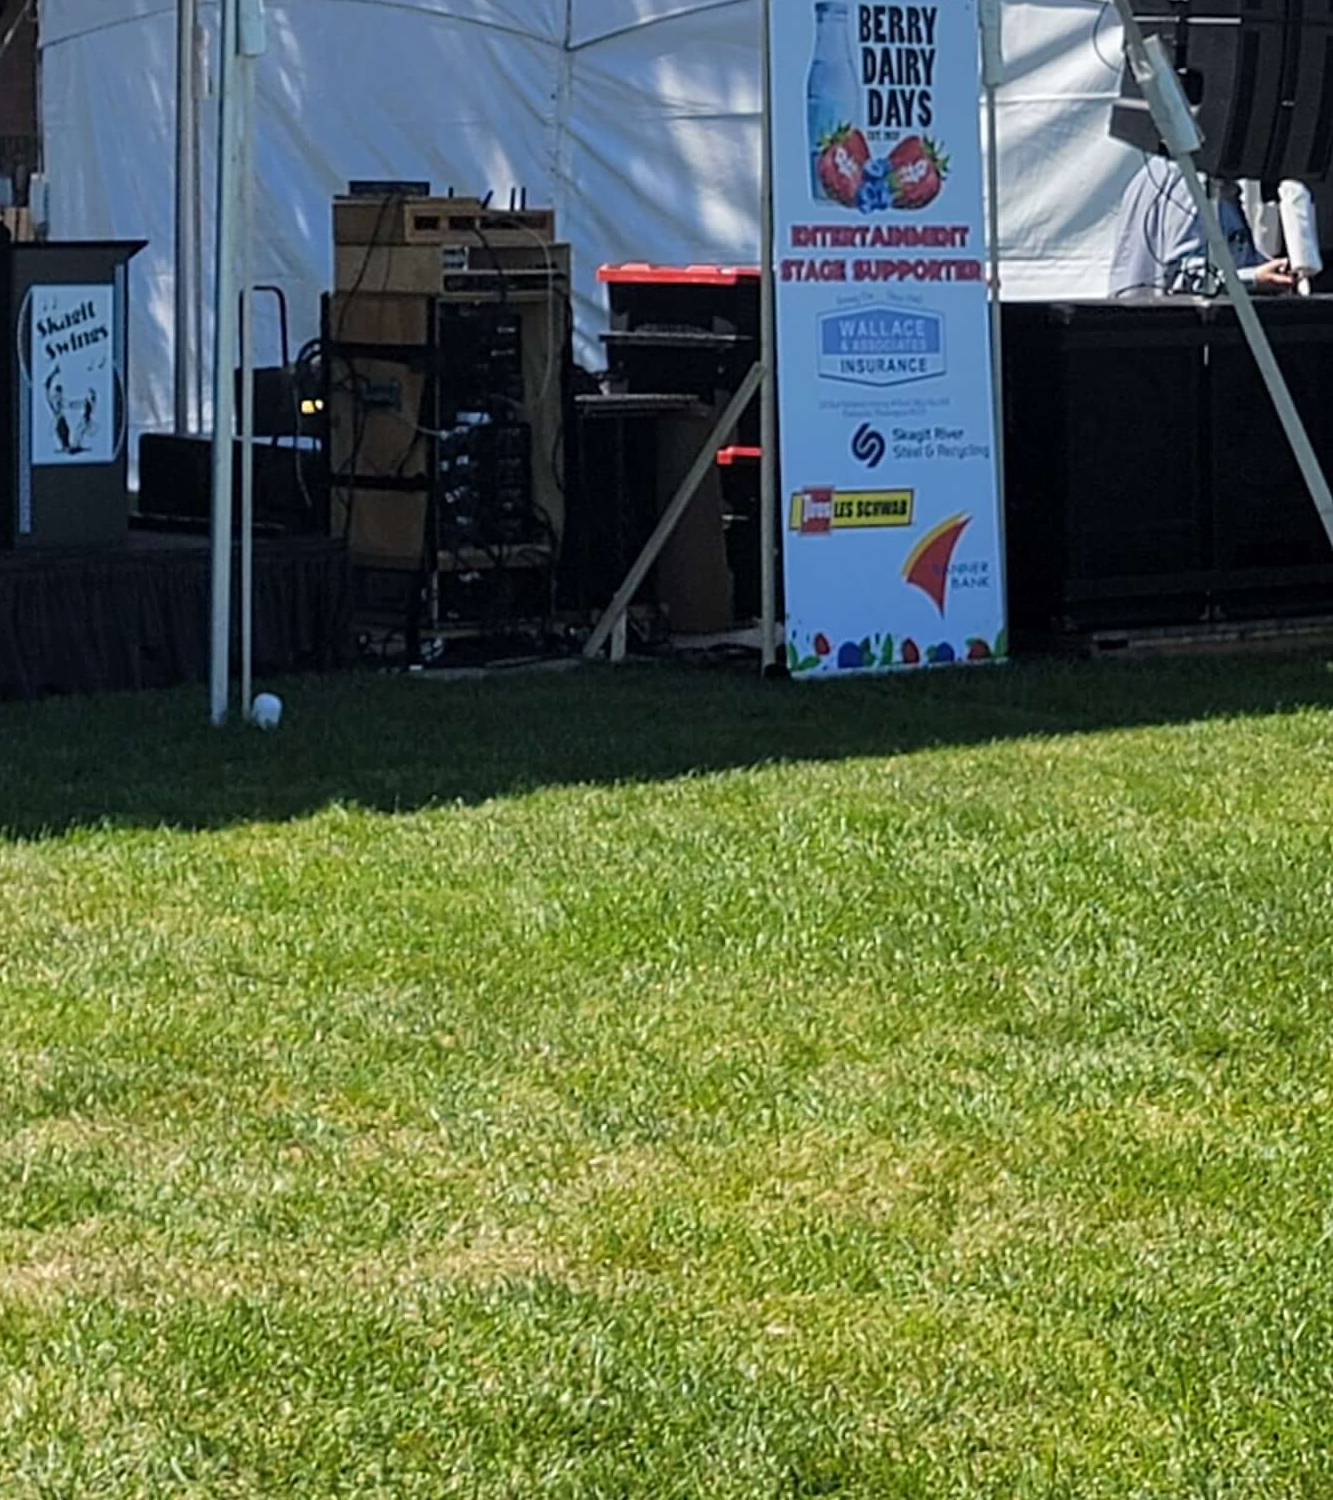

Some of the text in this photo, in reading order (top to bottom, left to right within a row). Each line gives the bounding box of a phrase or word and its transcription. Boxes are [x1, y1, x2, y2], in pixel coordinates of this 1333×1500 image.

[858, 4, 938, 46] BERRY
[861, 46, 936, 87] DAIRY
[868, 88, 933, 128] DAYS
[791, 224, 970, 249] ENTERTAINMENT
[781, 258, 982, 282] STAGE SUPPORTER
[36, 301, 97, 340] Skagit
[838, 318, 926, 338] WALLACE
[44, 325, 109, 360] Swings
[840, 357, 927, 374] INSURANCE
[892, 427, 965, 443] Skagit River
[950, 576, 989, 589] BANK
